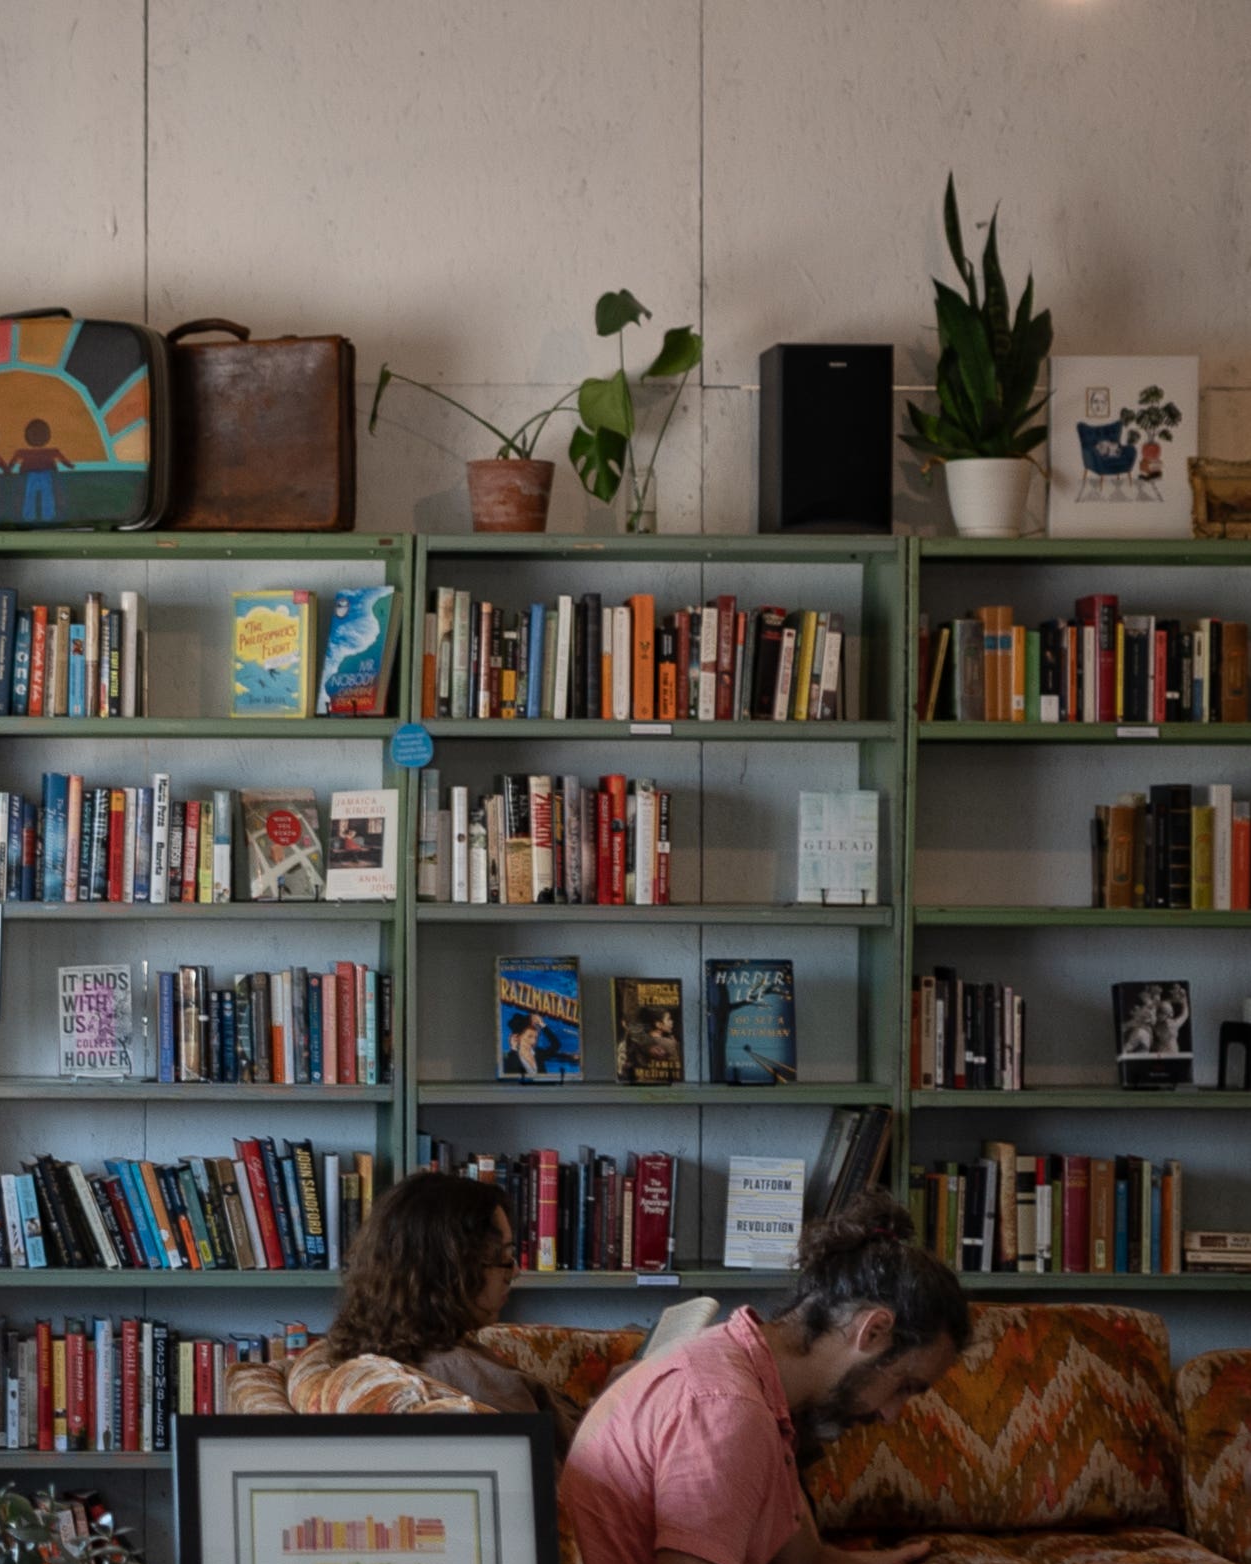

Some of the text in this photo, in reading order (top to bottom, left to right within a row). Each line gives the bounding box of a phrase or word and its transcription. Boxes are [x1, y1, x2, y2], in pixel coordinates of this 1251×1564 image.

[330, 674, 375, 687] NOBODY
[804, 840, 873, 851] GILEAD
[62, 972, 128, 992] IT ENDS
[715, 970, 785, 985] HARPER
[62, 994, 108, 1012] WITH
[500, 977, 580, 1026] RAZZMATAZZ
[736, 989, 765, 1002] LEE
[64, 1015, 86, 1033] US
[65, 1050, 129, 1067] HOOVER
[295, 1147, 314, 1179] JOHN
[743, 1178, 792, 1190] PLATFORM
[301, 1180, 324, 1235] SANDFORD
[737, 1220, 794, 1233] REVOLUTION
[127, 1328, 136, 1377] FRAGILE
[154, 1340, 166, 1437] SCUMBLER
